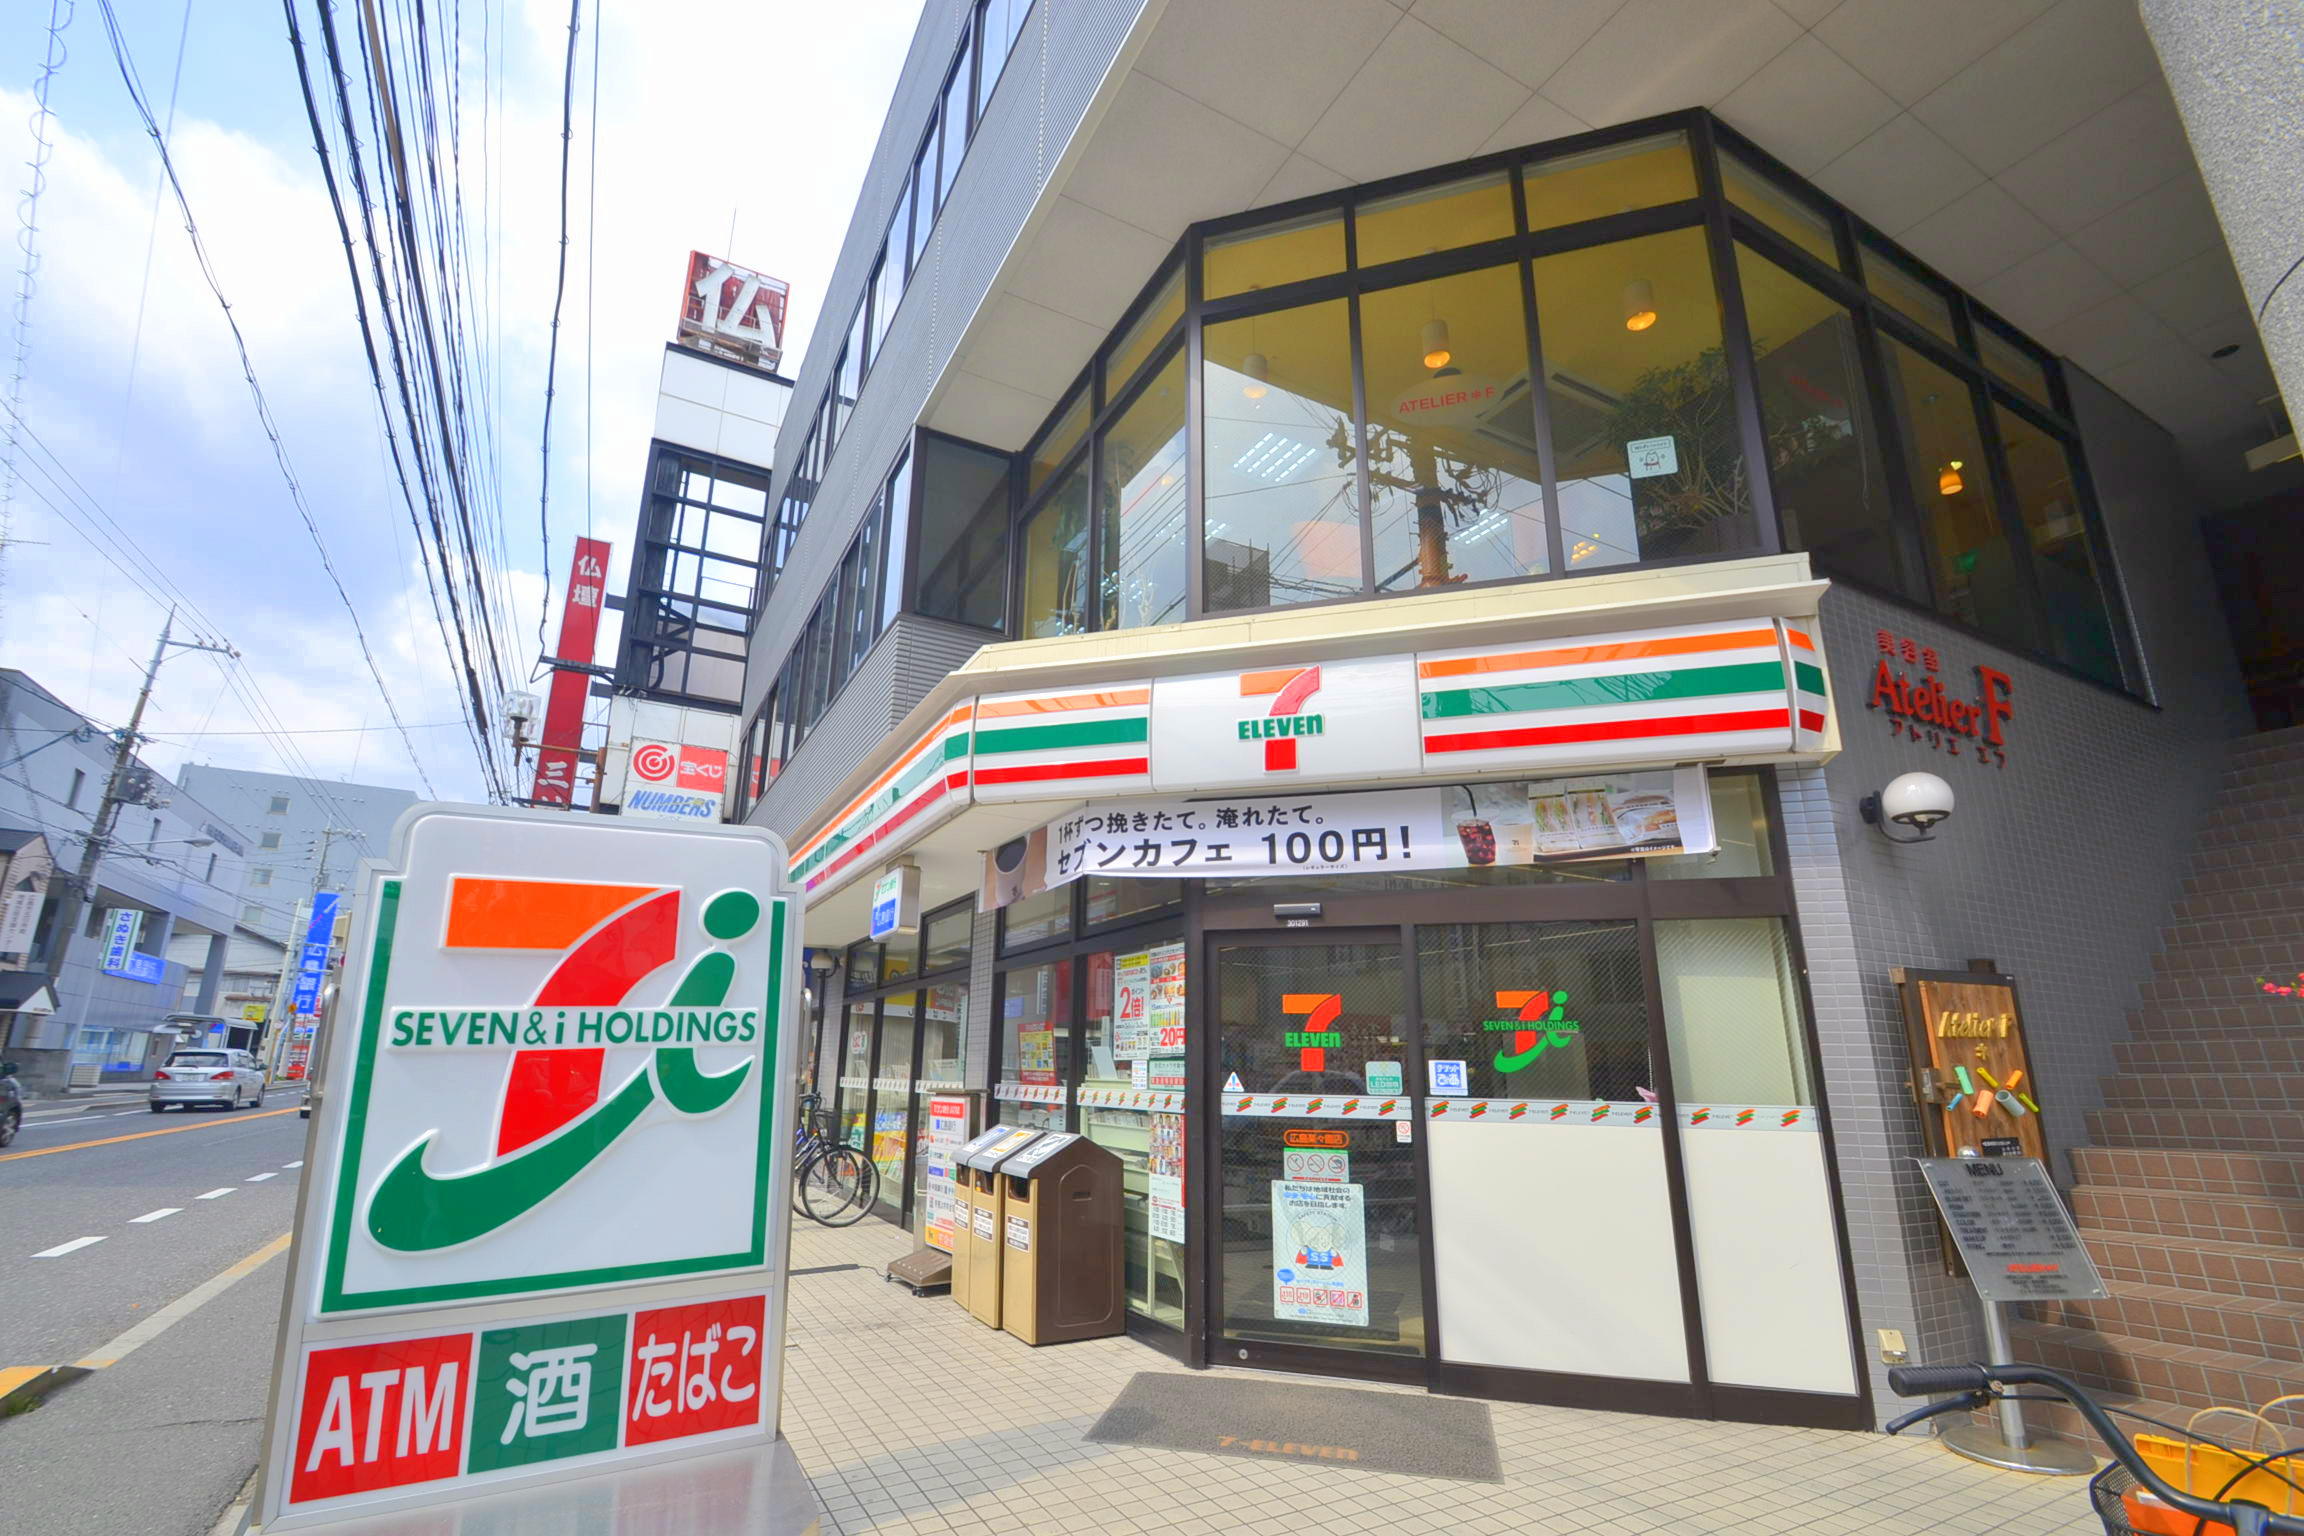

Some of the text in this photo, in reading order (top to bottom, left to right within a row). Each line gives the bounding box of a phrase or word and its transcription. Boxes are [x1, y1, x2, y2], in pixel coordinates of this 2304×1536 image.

[695, 263, 778, 350] 仏
[1399, 389, 1467, 414] ATELIER
[572, 554, 602, 608] 仏壇
[1871, 659, 1982, 737] Atelier
[680, 760, 723, 779] 宝くじ
[627, 789, 716, 818] NUMBERS
[1057, 836, 1233, 876] セブンカフェ
[577, 1011, 757, 1043] HOLDINGS
[1528, 1020, 1580, 1031] HOLDINGS
[1965, 1162, 2004, 1177] MENU
[631, 1322, 757, 1421] たばこ
[500, 1343, 598, 1445] 酒
[305, 1361, 459, 1473] ATM
